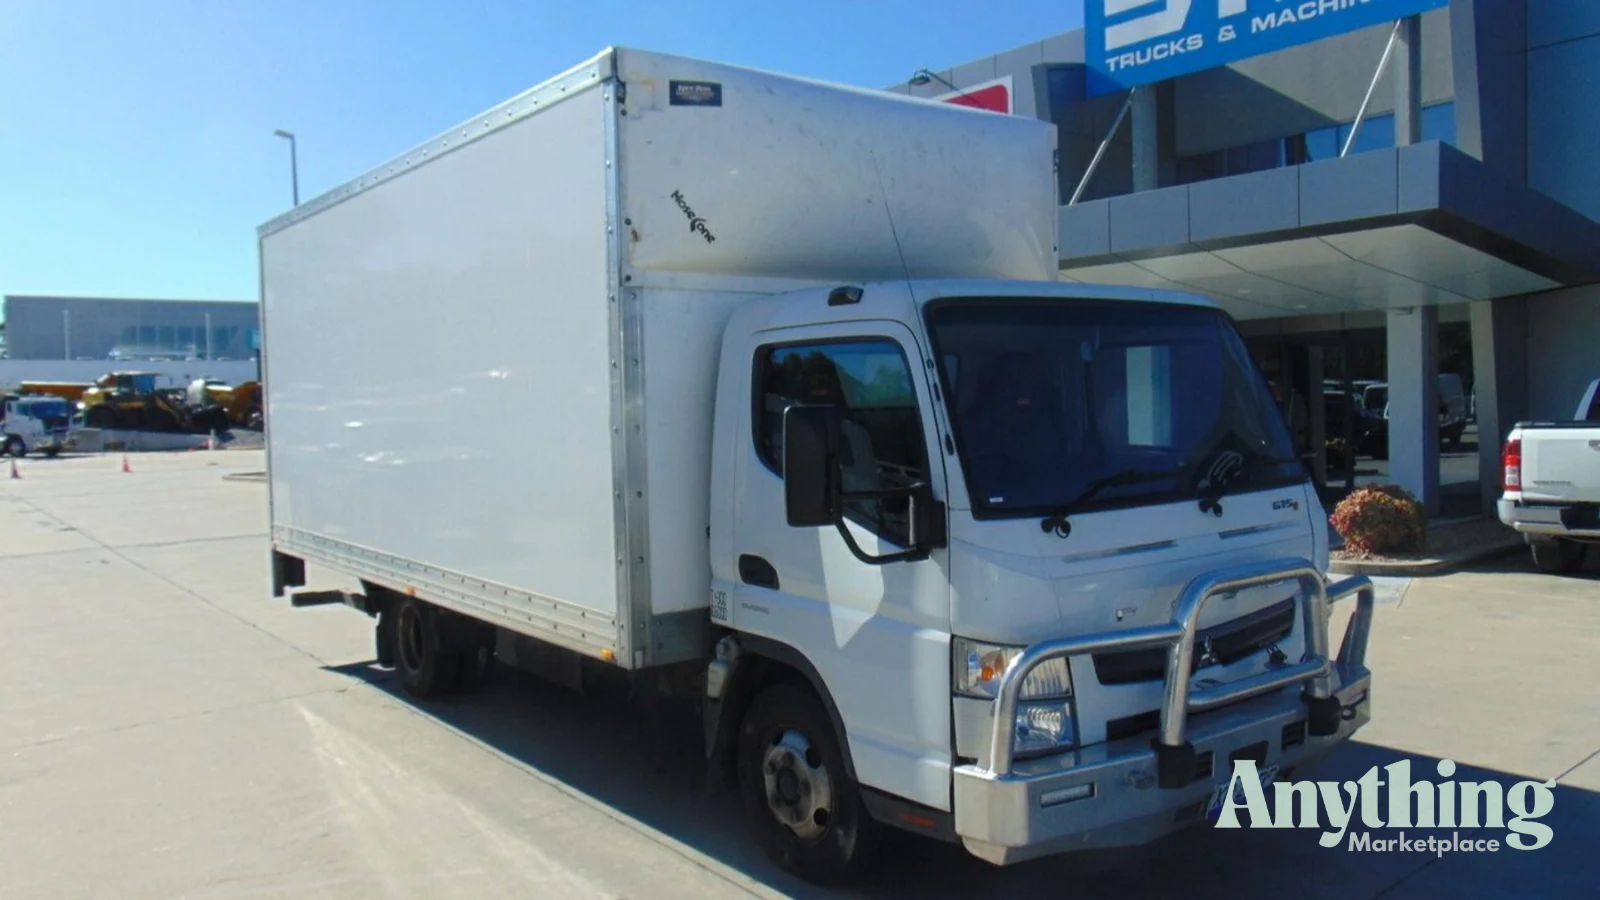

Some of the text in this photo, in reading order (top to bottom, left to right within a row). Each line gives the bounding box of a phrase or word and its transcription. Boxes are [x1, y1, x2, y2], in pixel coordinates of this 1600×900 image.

[1105, 33, 1204, 72] TRUCKS
[1217, 24, 1237, 43] &
[1251, 0, 1371, 34] MACHI
